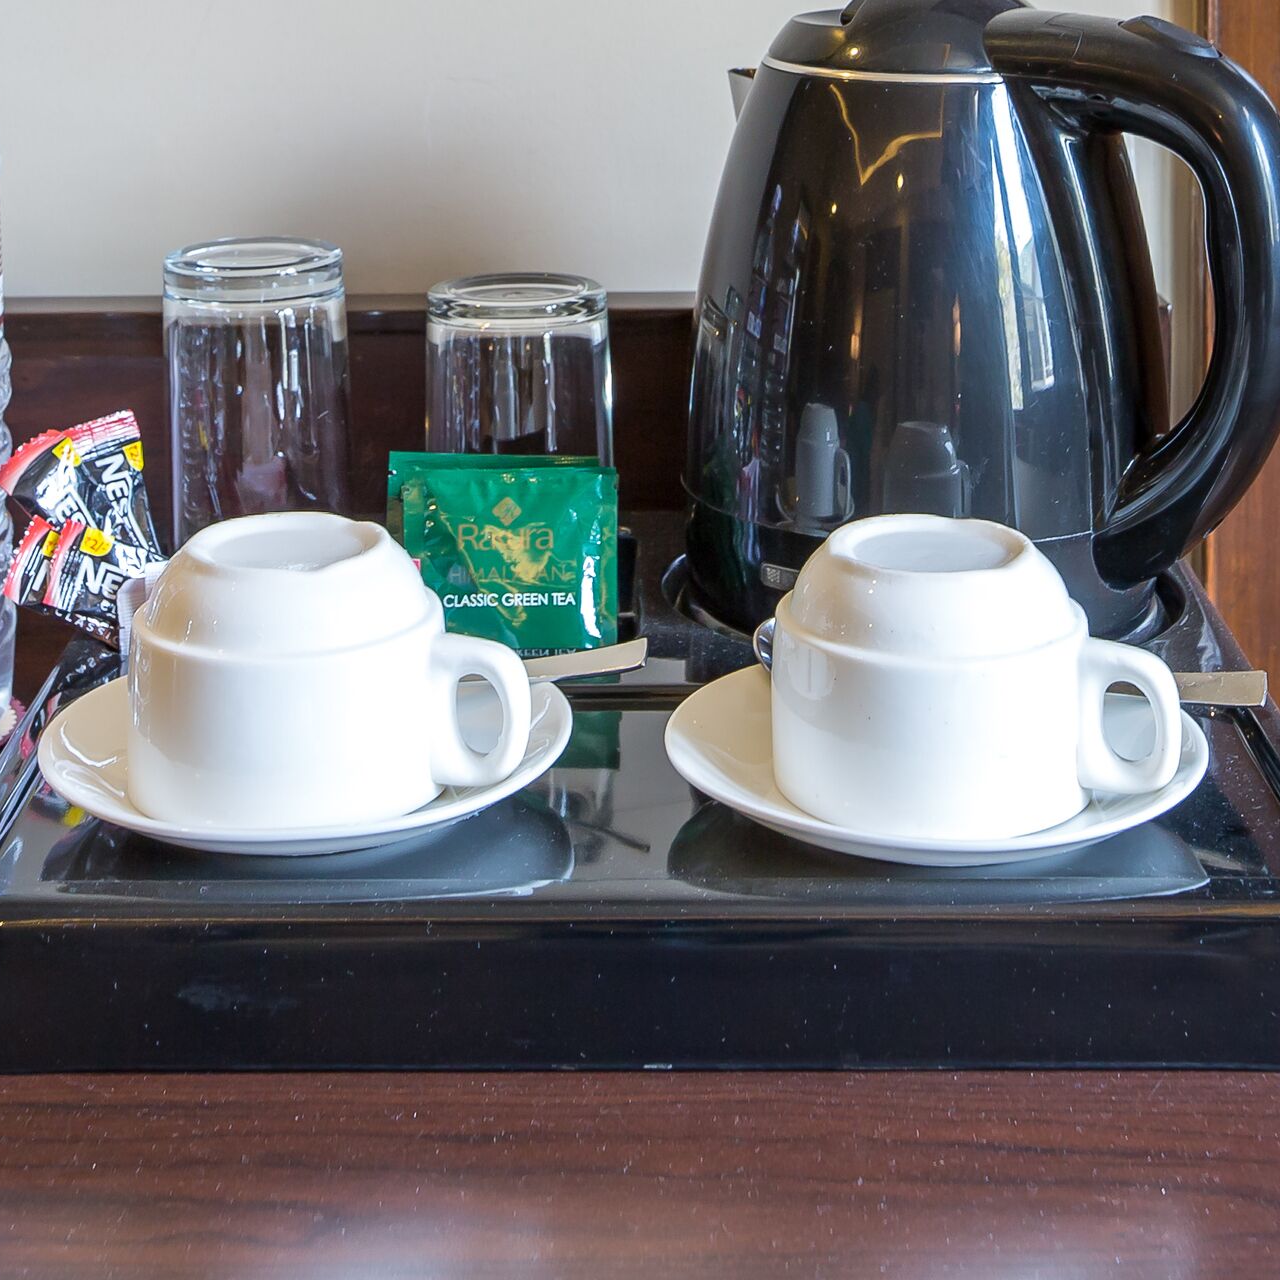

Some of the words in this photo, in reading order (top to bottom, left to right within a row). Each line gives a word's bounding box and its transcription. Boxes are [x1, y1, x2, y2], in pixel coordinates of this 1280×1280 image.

[443, 593, 499, 608] CLASSIC
[501, 592, 549, 607] GREEN
[550, 592, 577, 606] TEA
